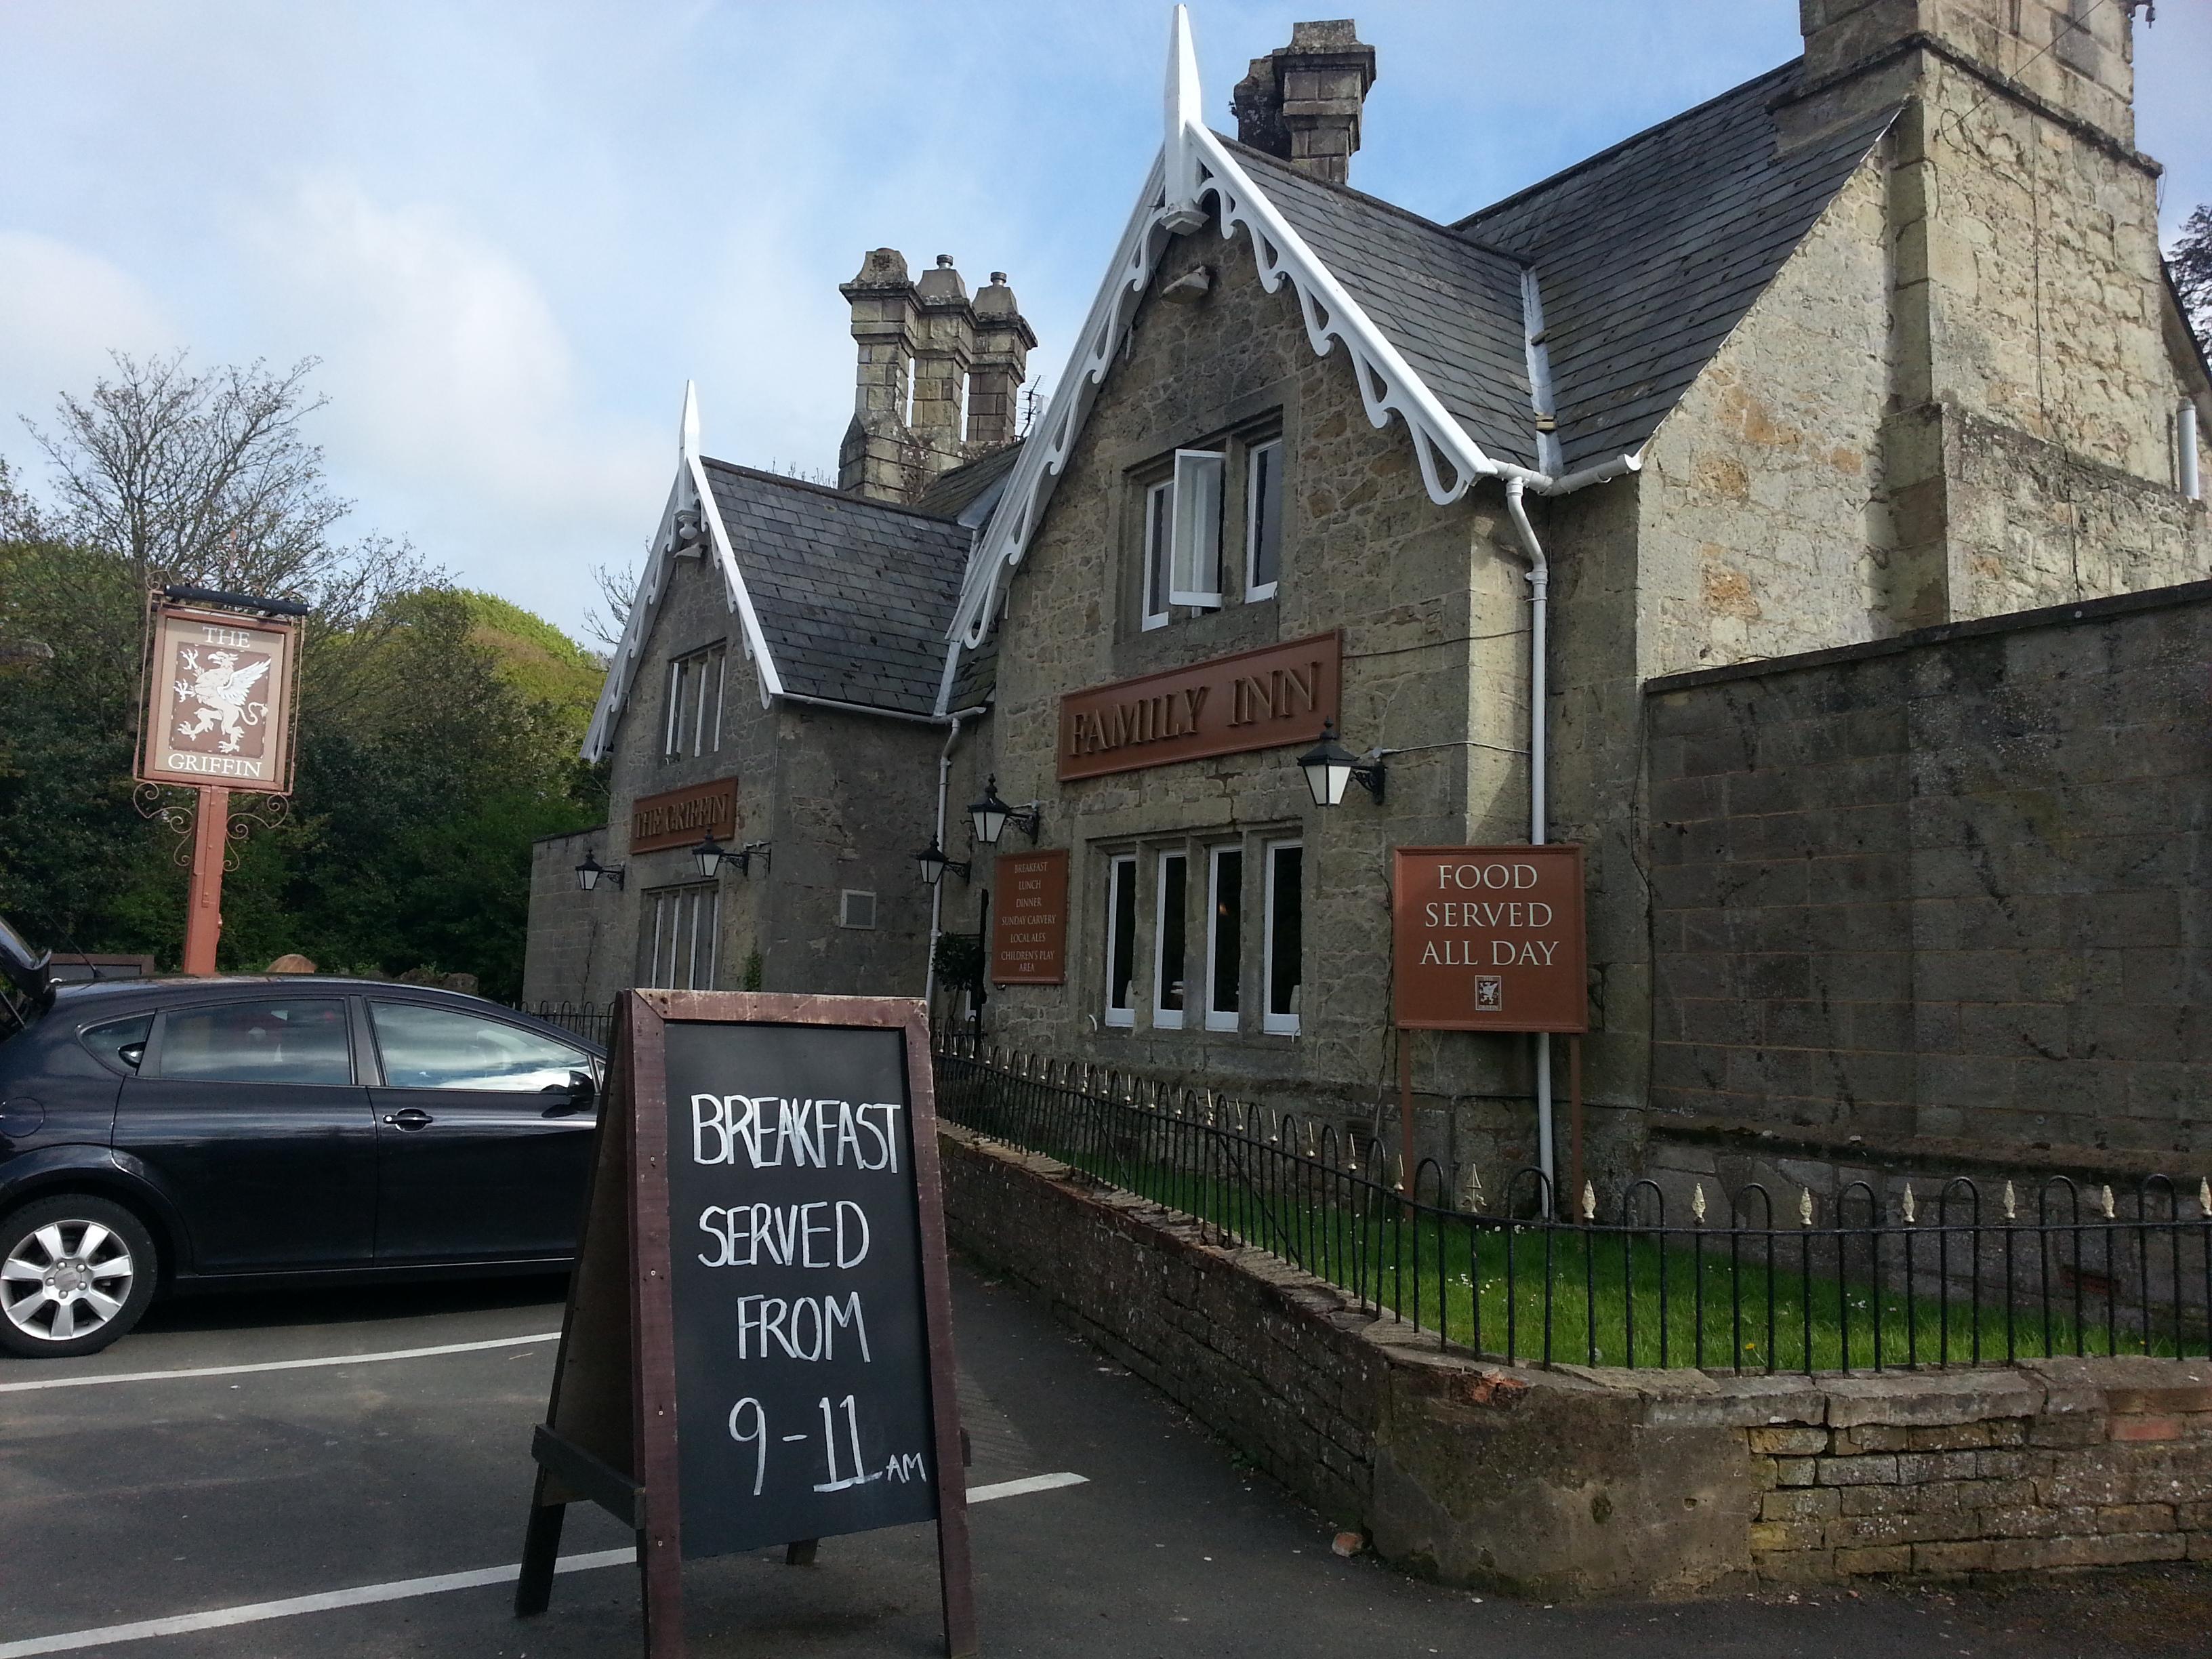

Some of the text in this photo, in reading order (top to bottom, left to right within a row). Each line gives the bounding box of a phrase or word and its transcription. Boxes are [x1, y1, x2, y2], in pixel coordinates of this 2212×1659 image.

[203, 626, 250, 649] THE
[1069, 661, 1319, 757] FAMILY INN
[167, 753, 262, 777] GRIFFIN
[634, 792, 729, 838] THE GRIFFIN
[1015, 862, 1048, 874] BREAKFAST
[1438, 865, 1538, 889] FOOD
[1019, 880, 1041, 890] LUNCH
[1016, 897, 1042, 907] DINNER
[1002, 915, 1056, 926] SUNDAY CARVERY
[1425, 903, 1553, 927] SERVED
[1010, 933, 1046, 943] LOCAL ALES
[1001, 951, 1054, 960] CHILDREN'S PLAY
[1419, 941, 1559, 965] ALL DAY
[1019, 962, 1035, 972] AREA
[691, 1093, 901, 1174] BREAKFAST
[697, 1200, 870, 1269] SERVED
[737, 1290, 872, 1364] FROM
[886, 1452, 926, 1483] AM
